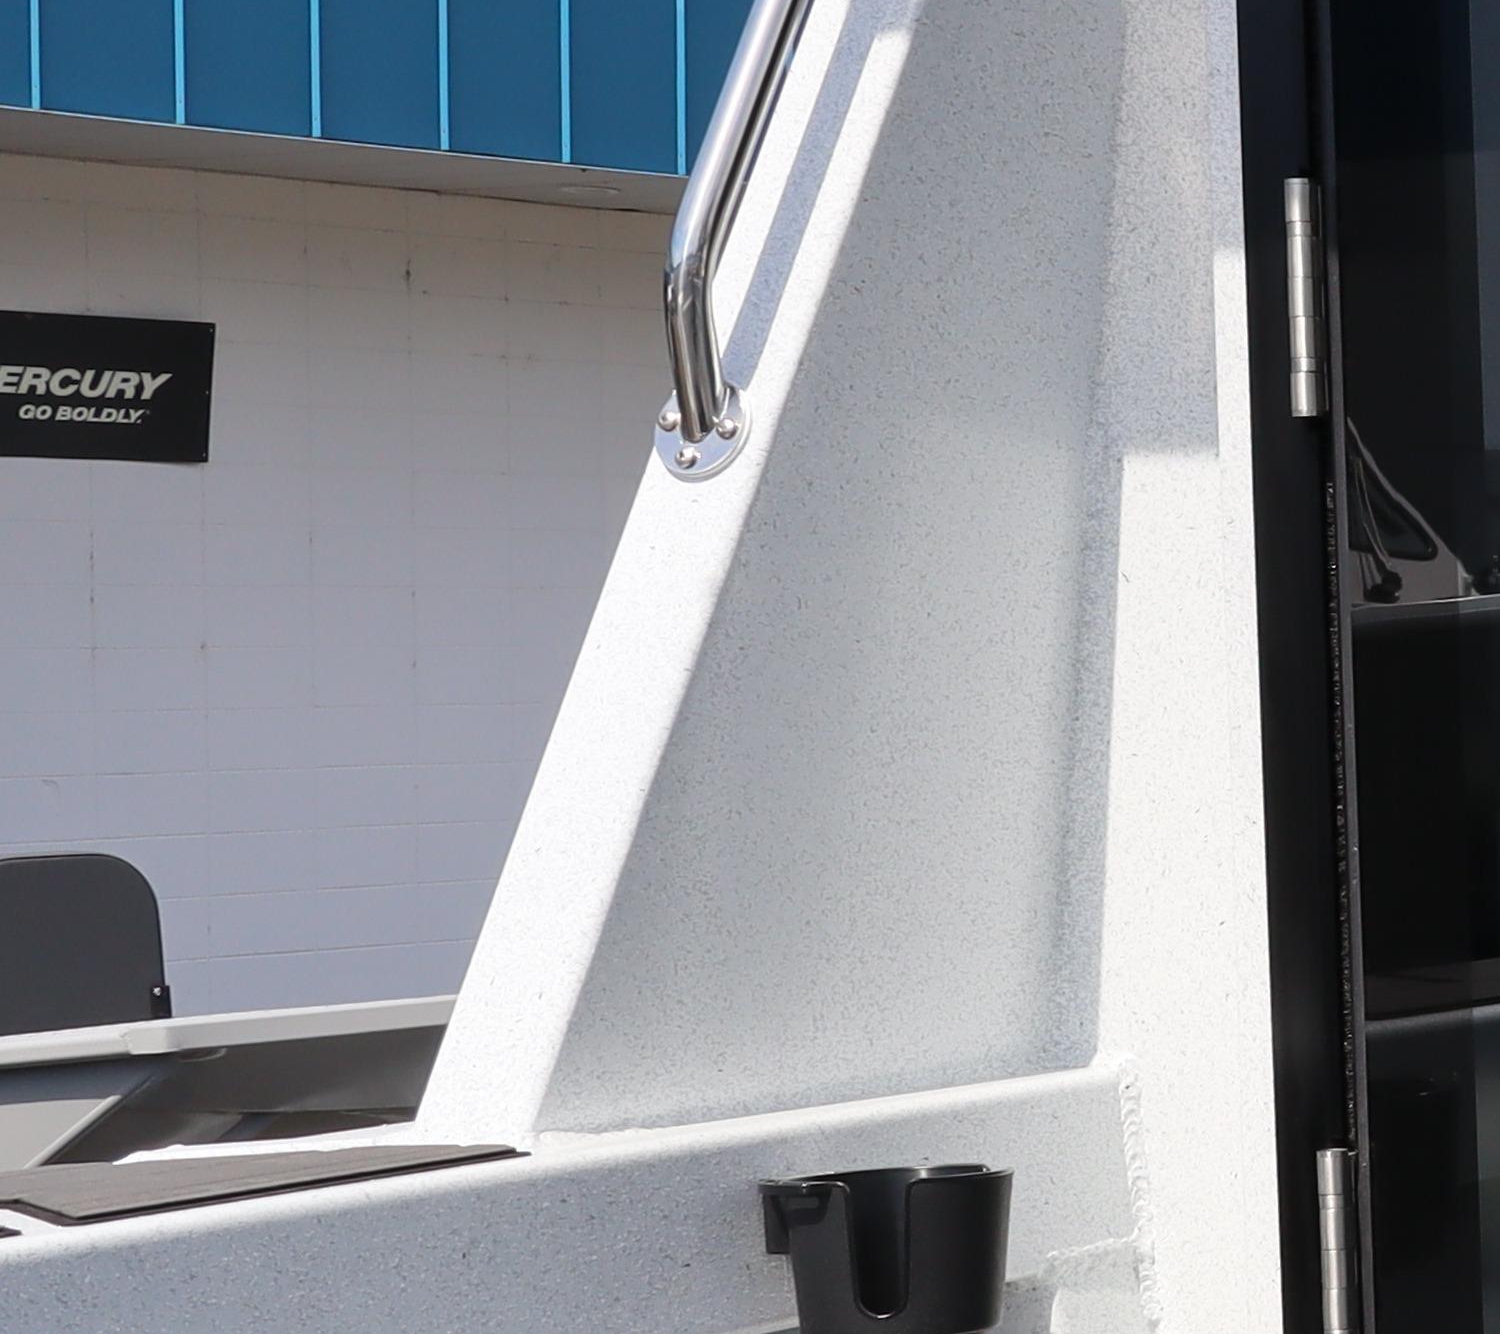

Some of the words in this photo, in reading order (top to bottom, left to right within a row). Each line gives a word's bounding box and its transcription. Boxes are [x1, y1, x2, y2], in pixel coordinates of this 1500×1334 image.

[0, 365, 172, 400] ERCURY
[18, 404, 52, 420] GO
[54, 406, 144, 424] BOLDLY.
